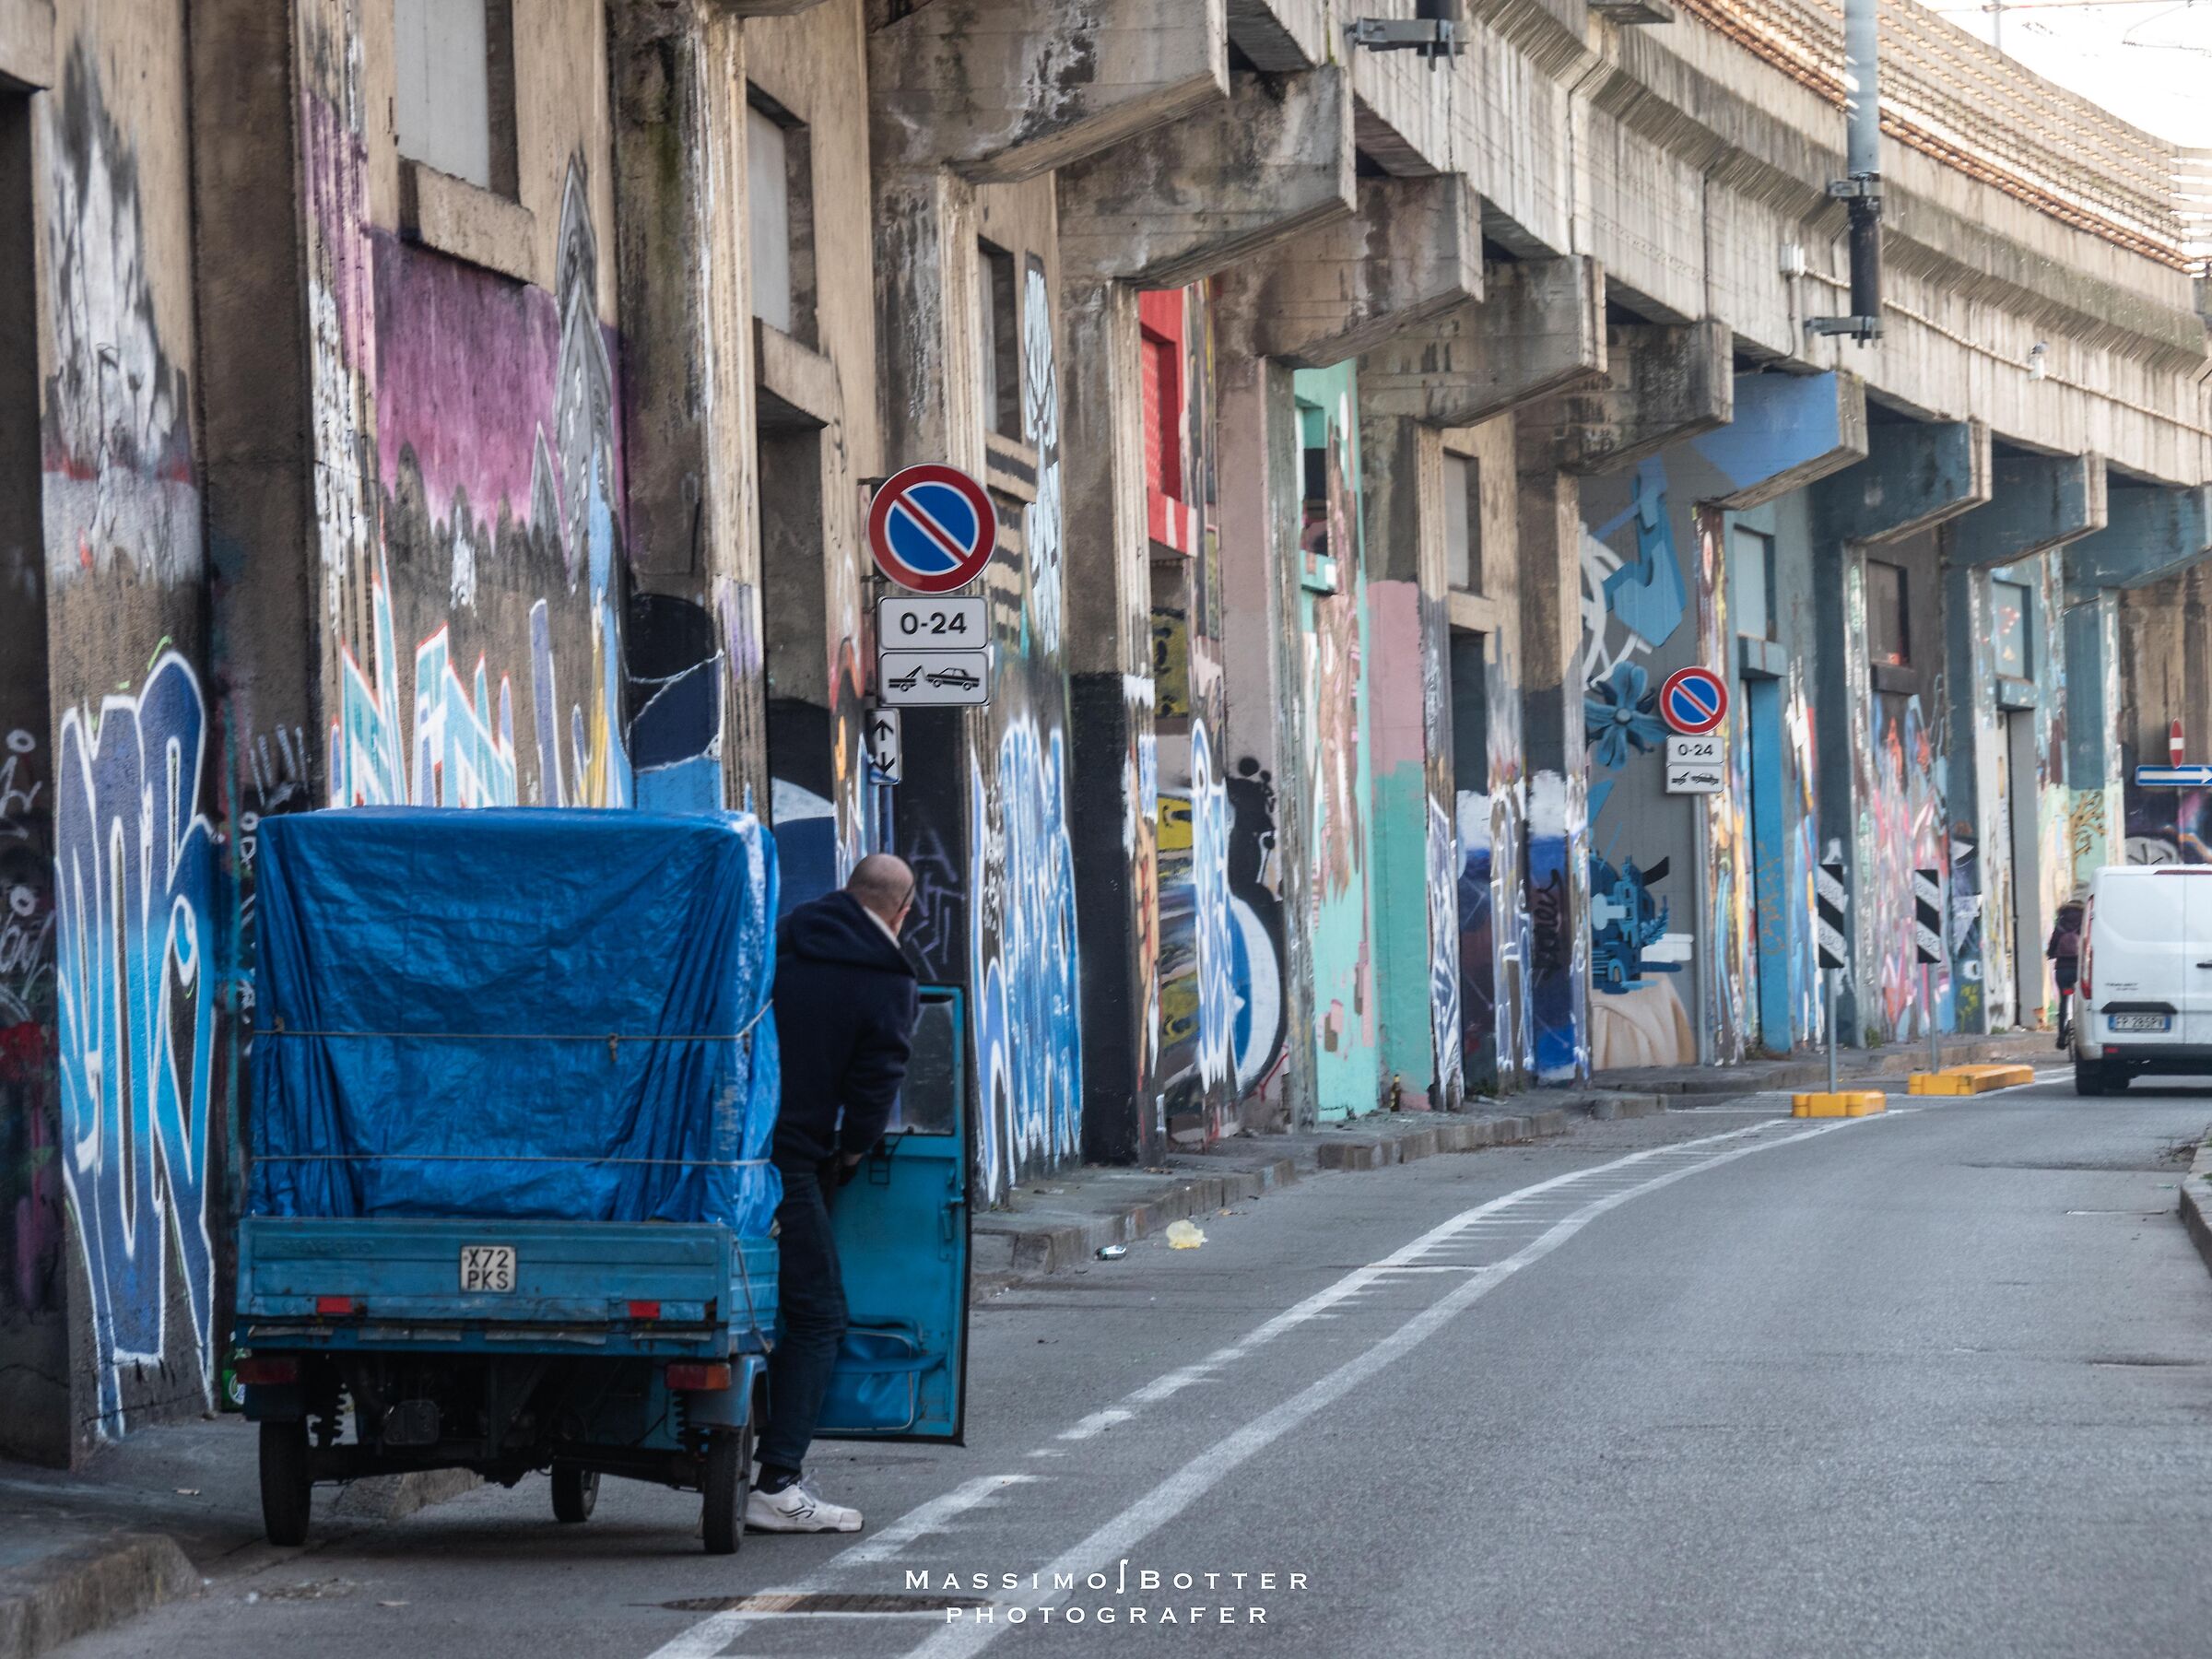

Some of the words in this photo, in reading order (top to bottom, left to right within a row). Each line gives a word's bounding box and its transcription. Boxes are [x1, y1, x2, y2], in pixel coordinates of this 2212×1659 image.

[900, 612, 967, 635] 0-24
[1677, 743, 1713, 756] 0-24
[468, 1248, 509, 1268] X72
[467, 1270, 509, 1289] PKS
